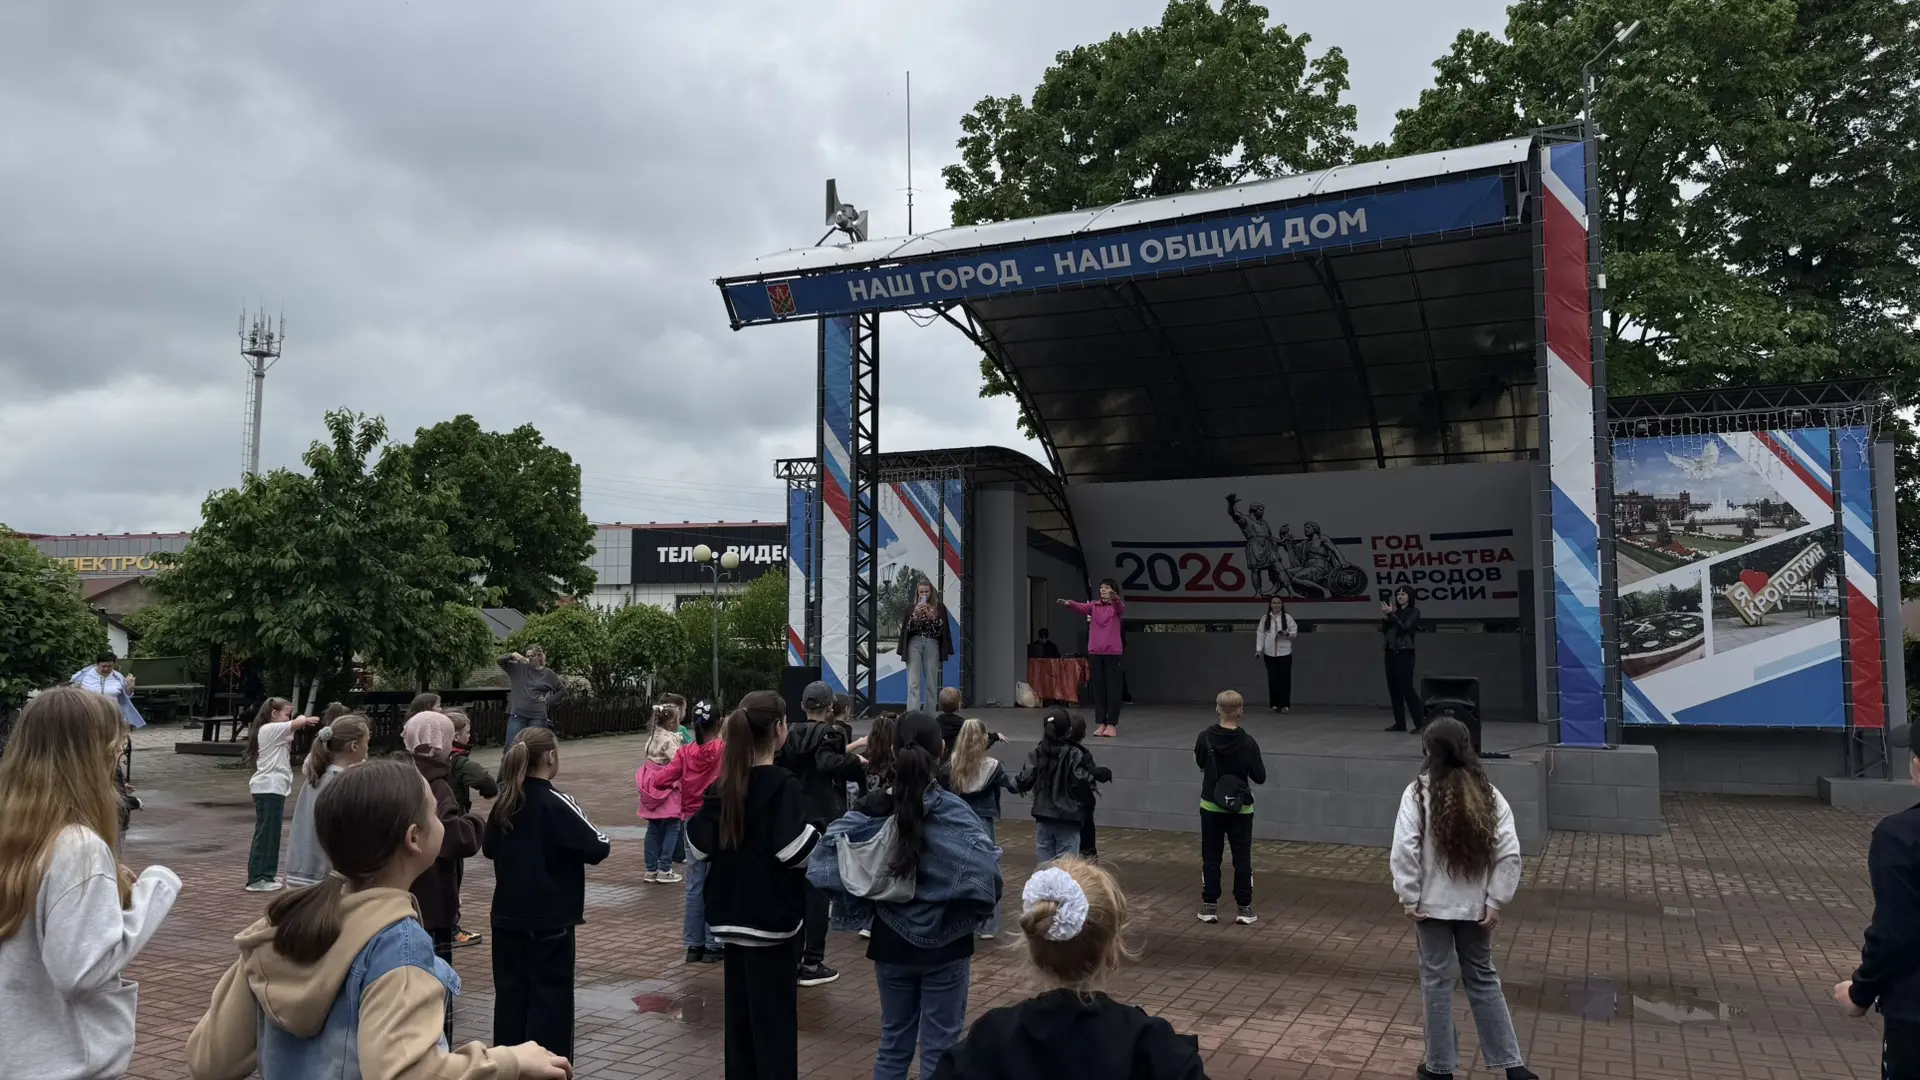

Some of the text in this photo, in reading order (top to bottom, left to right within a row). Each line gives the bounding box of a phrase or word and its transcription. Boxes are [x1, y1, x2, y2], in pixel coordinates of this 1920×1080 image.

[847, 207, 1368, 301] НАШ ГОРОД - НАШ ОБЩИЙ ДОМ
[1371, 534, 1423, 551] ГОД
[1373, 548, 1516, 569] ЕДИНСТВА
[1115, 552, 1246, 592] 2026
[1375, 567, 1502, 585] НАРОДОВ
[1744, 544, 1827, 621] КРОПОТКИН
[1378, 586, 1486, 601] РССИИ
[1734, 587, 1751, 607] Я
